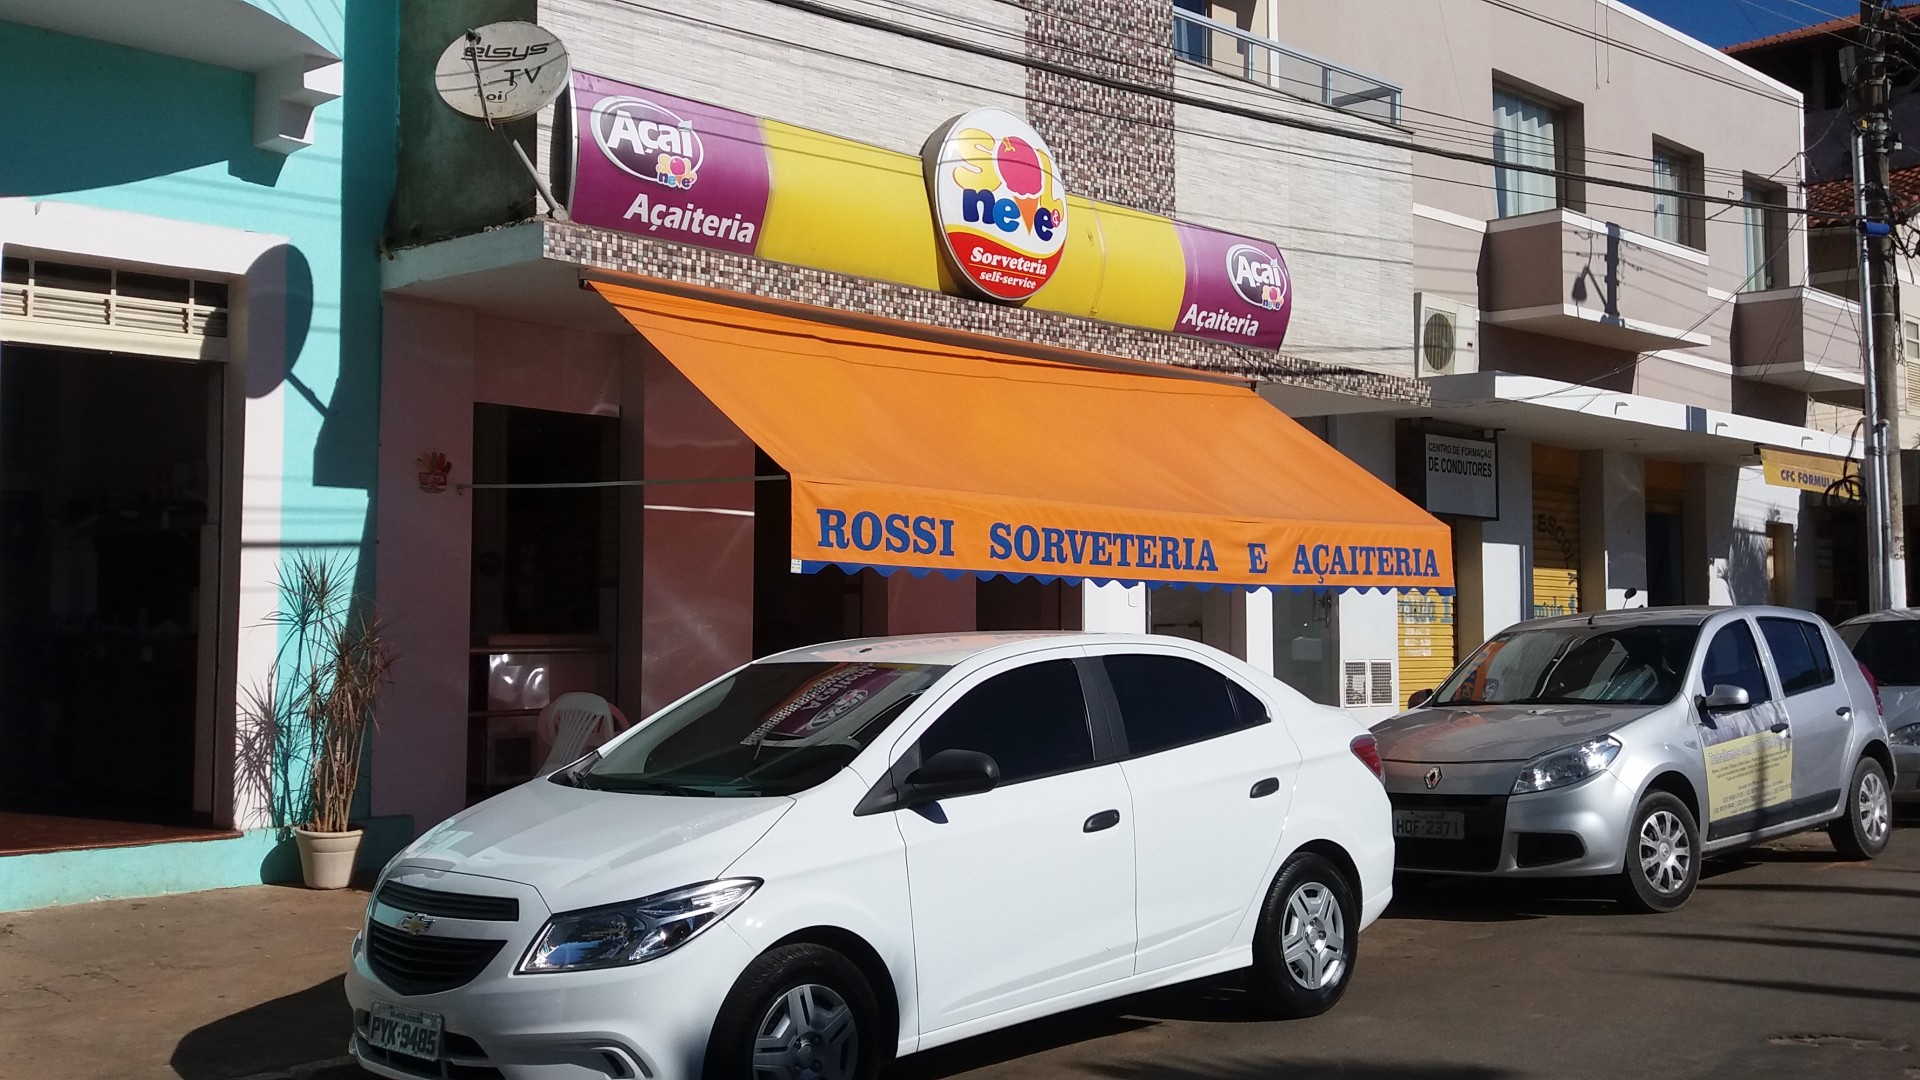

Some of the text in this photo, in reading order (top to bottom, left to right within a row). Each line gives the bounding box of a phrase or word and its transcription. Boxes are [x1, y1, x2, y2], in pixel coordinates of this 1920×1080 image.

[504, 66, 541, 87] TV
[623, 193, 755, 244] Açaiteria
[970, 246, 1047, 275] Sorveteria
[979, 270, 1037, 289] self-service
[1181, 304, 1259, 337] Açaiteria
[1429, 442, 1451, 454] CENTRO
[1452, 445, 1460, 455] DE
[1429, 457, 1492, 478] DE CONDUTORES
[1781, 469, 1796, 482] CFC
[817, 508, 1440, 584] ROSSI SORVETERIA E AÇAITERIA
